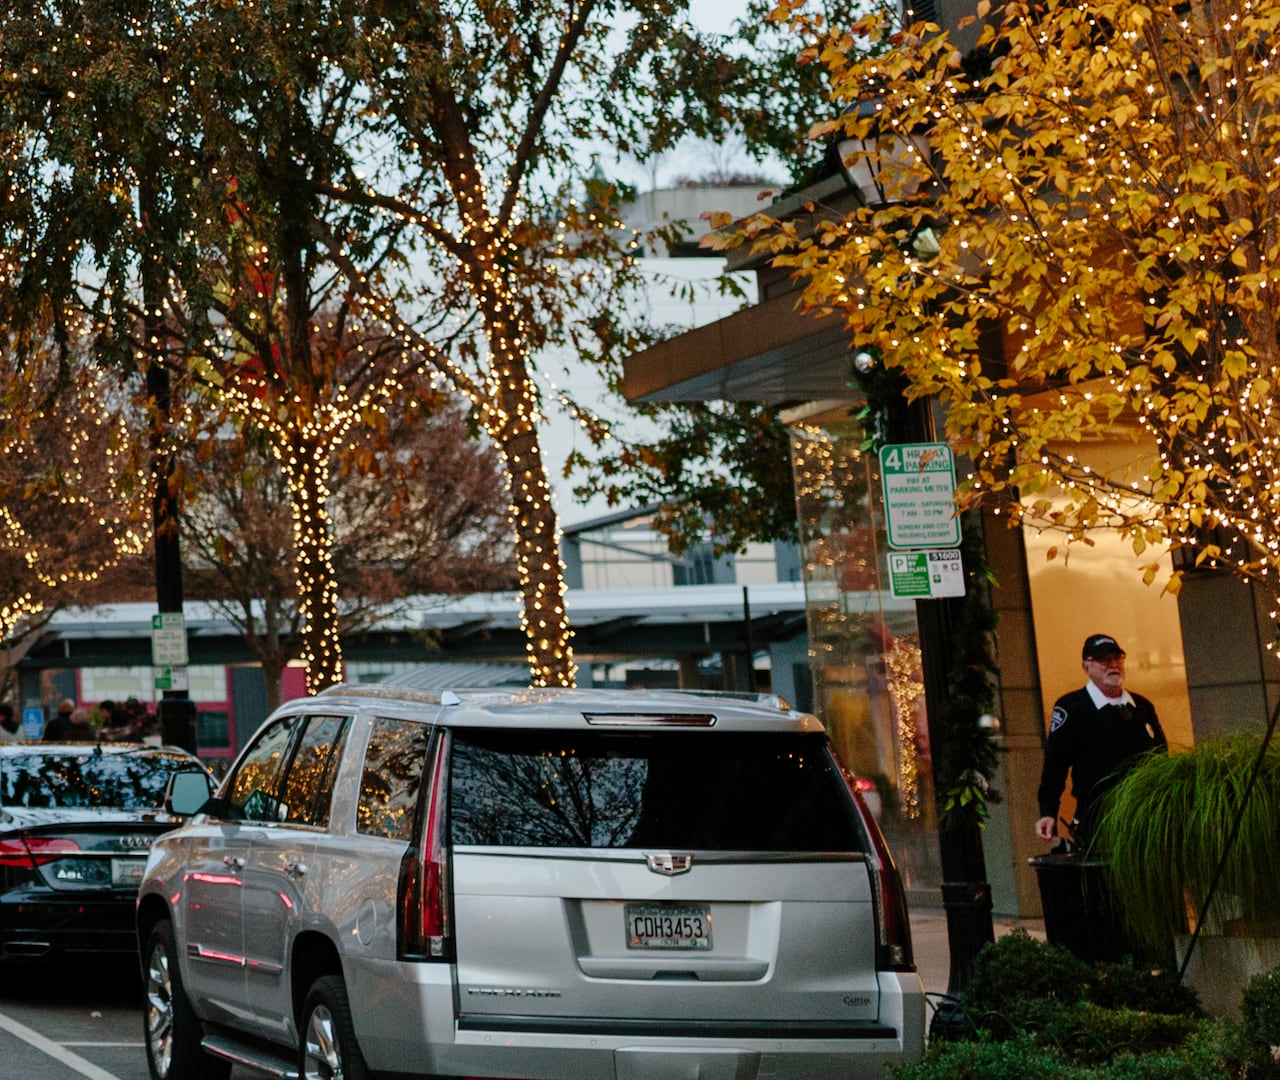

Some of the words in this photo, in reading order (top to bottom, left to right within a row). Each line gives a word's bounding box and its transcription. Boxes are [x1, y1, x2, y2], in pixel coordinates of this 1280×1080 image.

[885, 449, 902, 471] 4
[907, 450, 920, 459] HR
[905, 460, 949, 471] PAKING
[890, 486, 922, 494] PARKING
[895, 558, 904, 569] P
[633, 917, 704, 938] CDH3453
